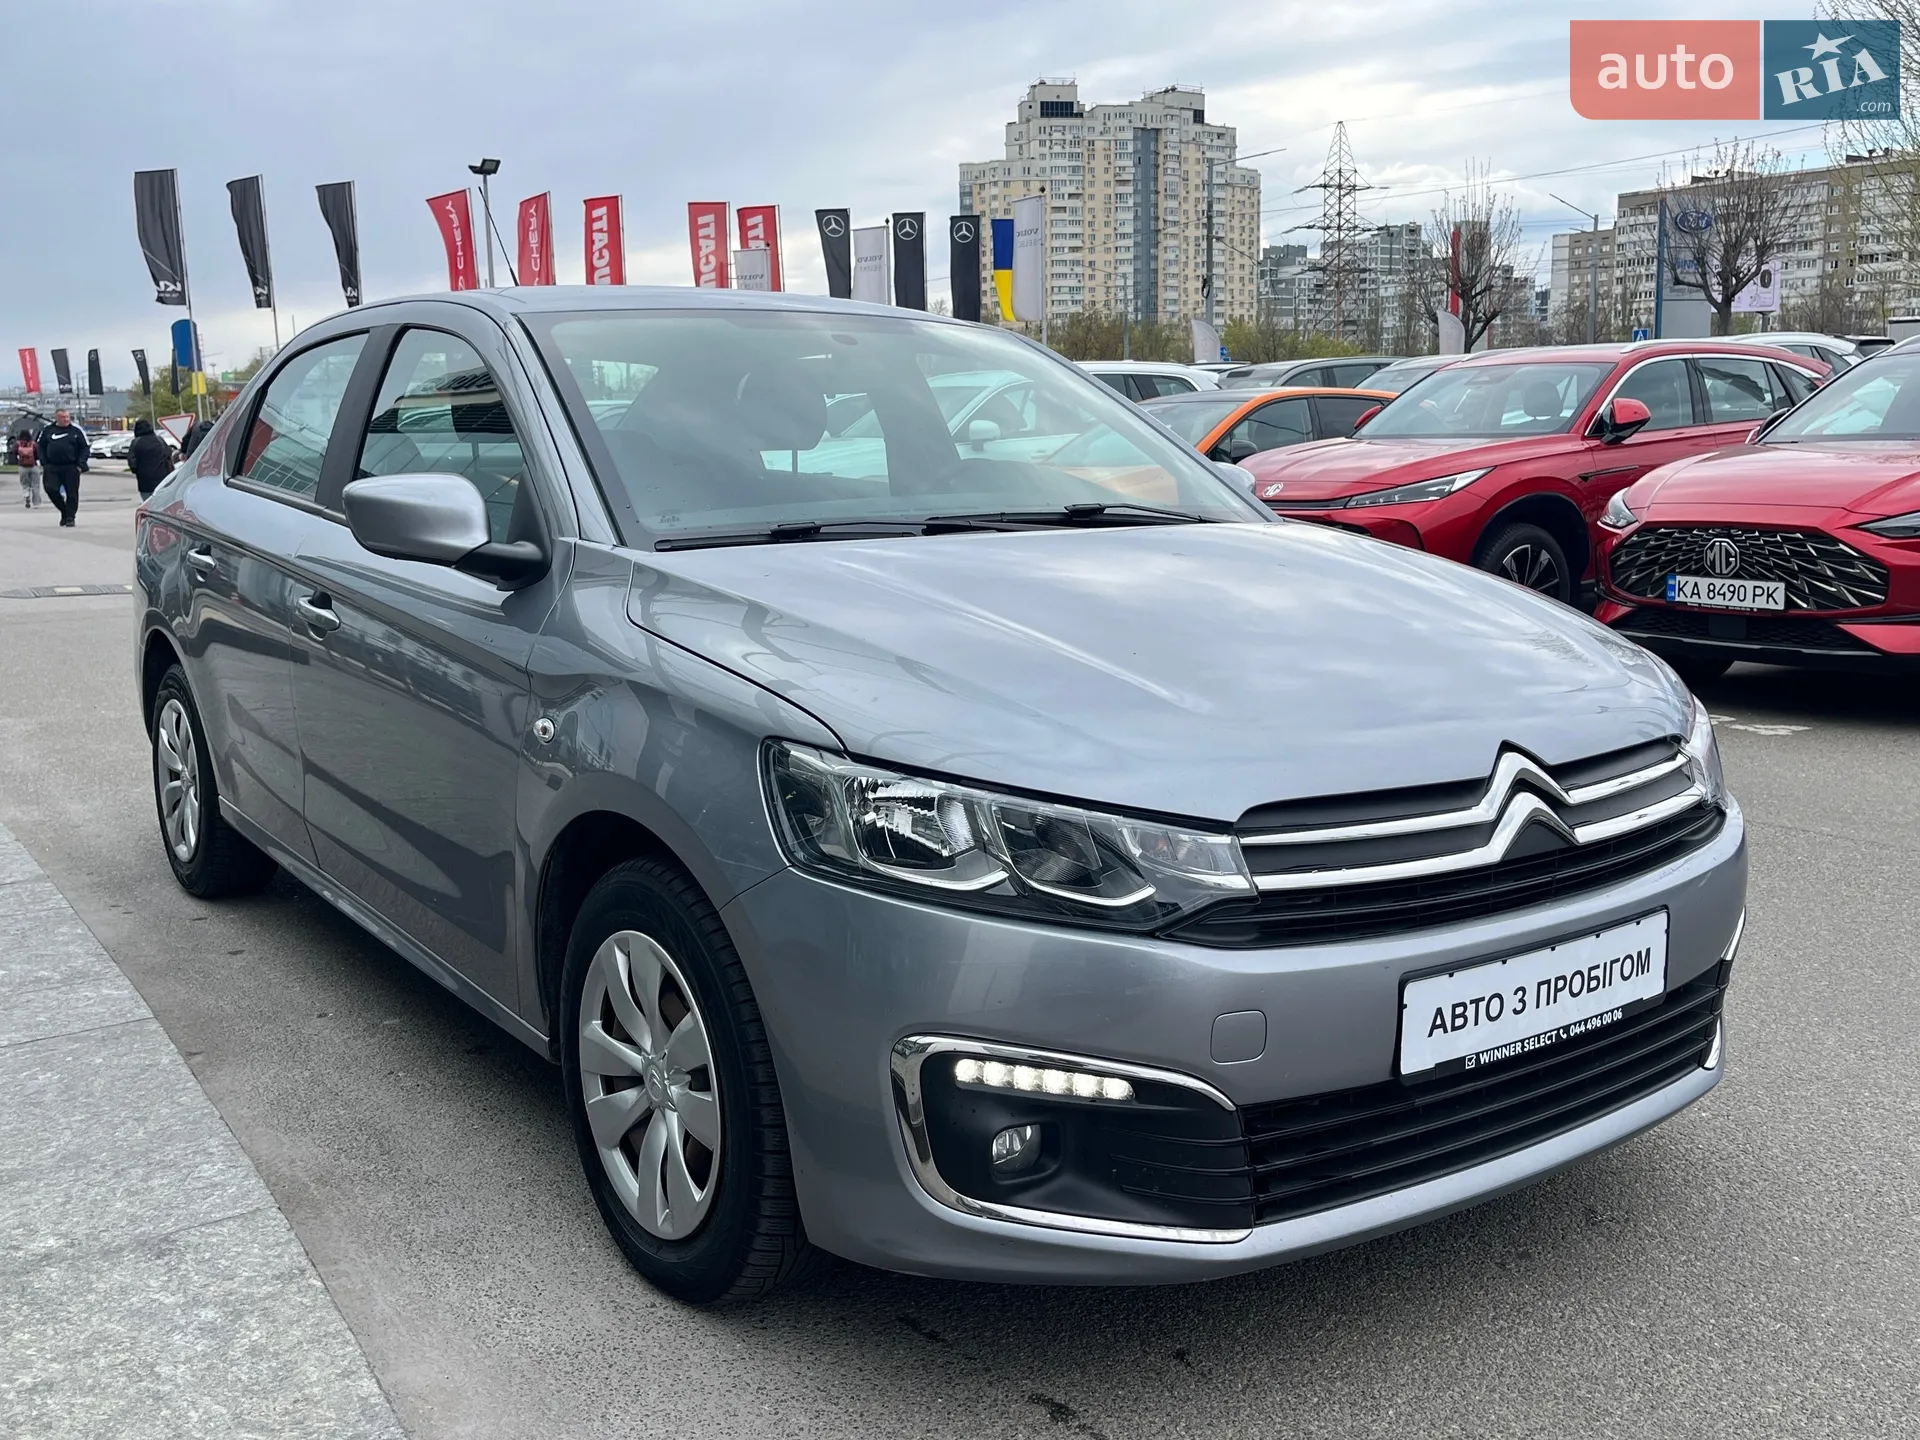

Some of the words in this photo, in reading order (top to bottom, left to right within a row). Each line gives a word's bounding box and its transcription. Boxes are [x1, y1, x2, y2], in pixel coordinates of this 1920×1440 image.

[1706, 542, 1736, 574] MG
[1677, 580, 1701, 600] KA
[1707, 582, 1747, 602] 8490
[1752, 585, 1779, 605] PK
[1427, 992, 1505, 1038] АВТО
[1535, 947, 1651, 1010] ПРОБІГОМ
[1479, 1042, 1523, 1065] WINNER
[1523, 1030, 1558, 1051] SELECT
[1569, 1022, 1586, 1037] 044
[1586, 1017, 1602, 1031] 496
[1602, 1012, 1613, 1026] 00
[1613, 1007, 1623, 1021] 06
